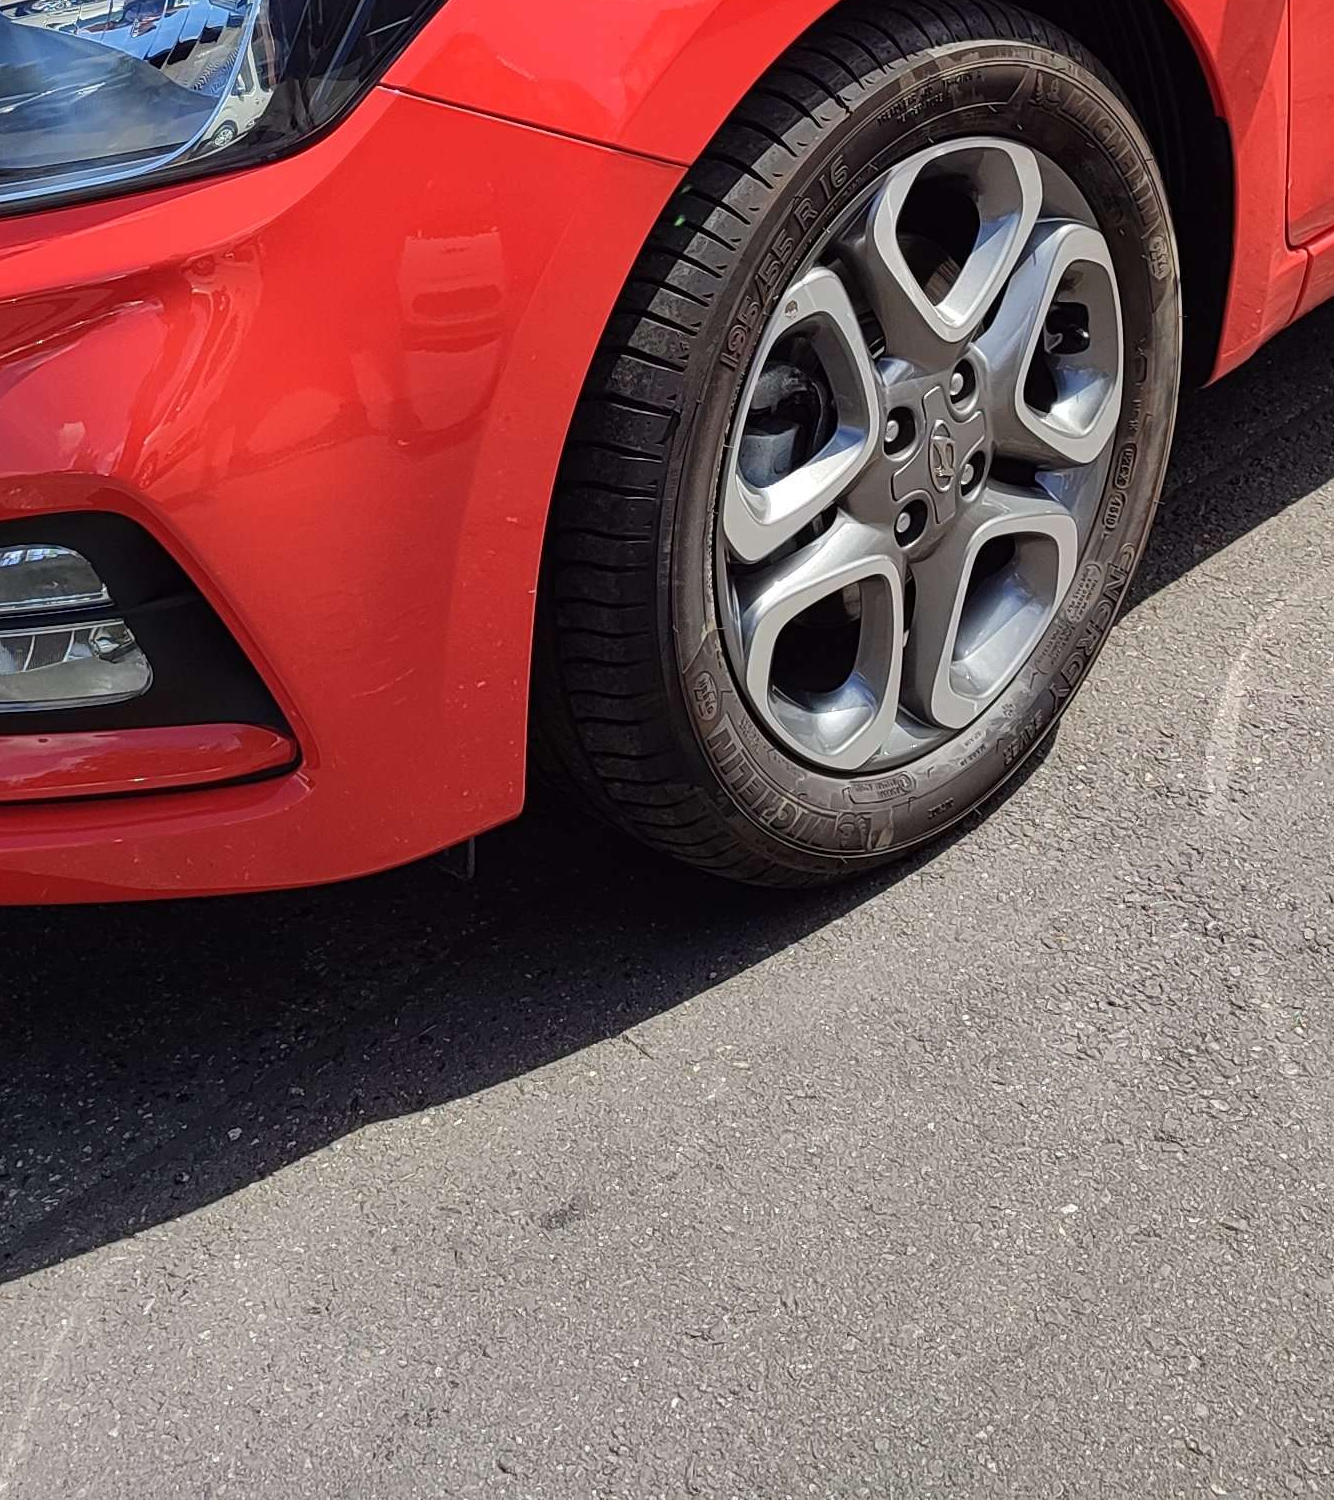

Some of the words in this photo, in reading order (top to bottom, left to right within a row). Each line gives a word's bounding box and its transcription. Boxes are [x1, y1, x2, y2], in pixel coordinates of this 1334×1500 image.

[1065, 85, 1161, 234] MICHELIN
[720, 228, 796, 373] 195/55
[794, 197, 819, 232] R
[818, 154, 851, 200] 16
[1048, 542, 1135, 713] ENERGY
[706, 726, 837, 850] MICHELIN
